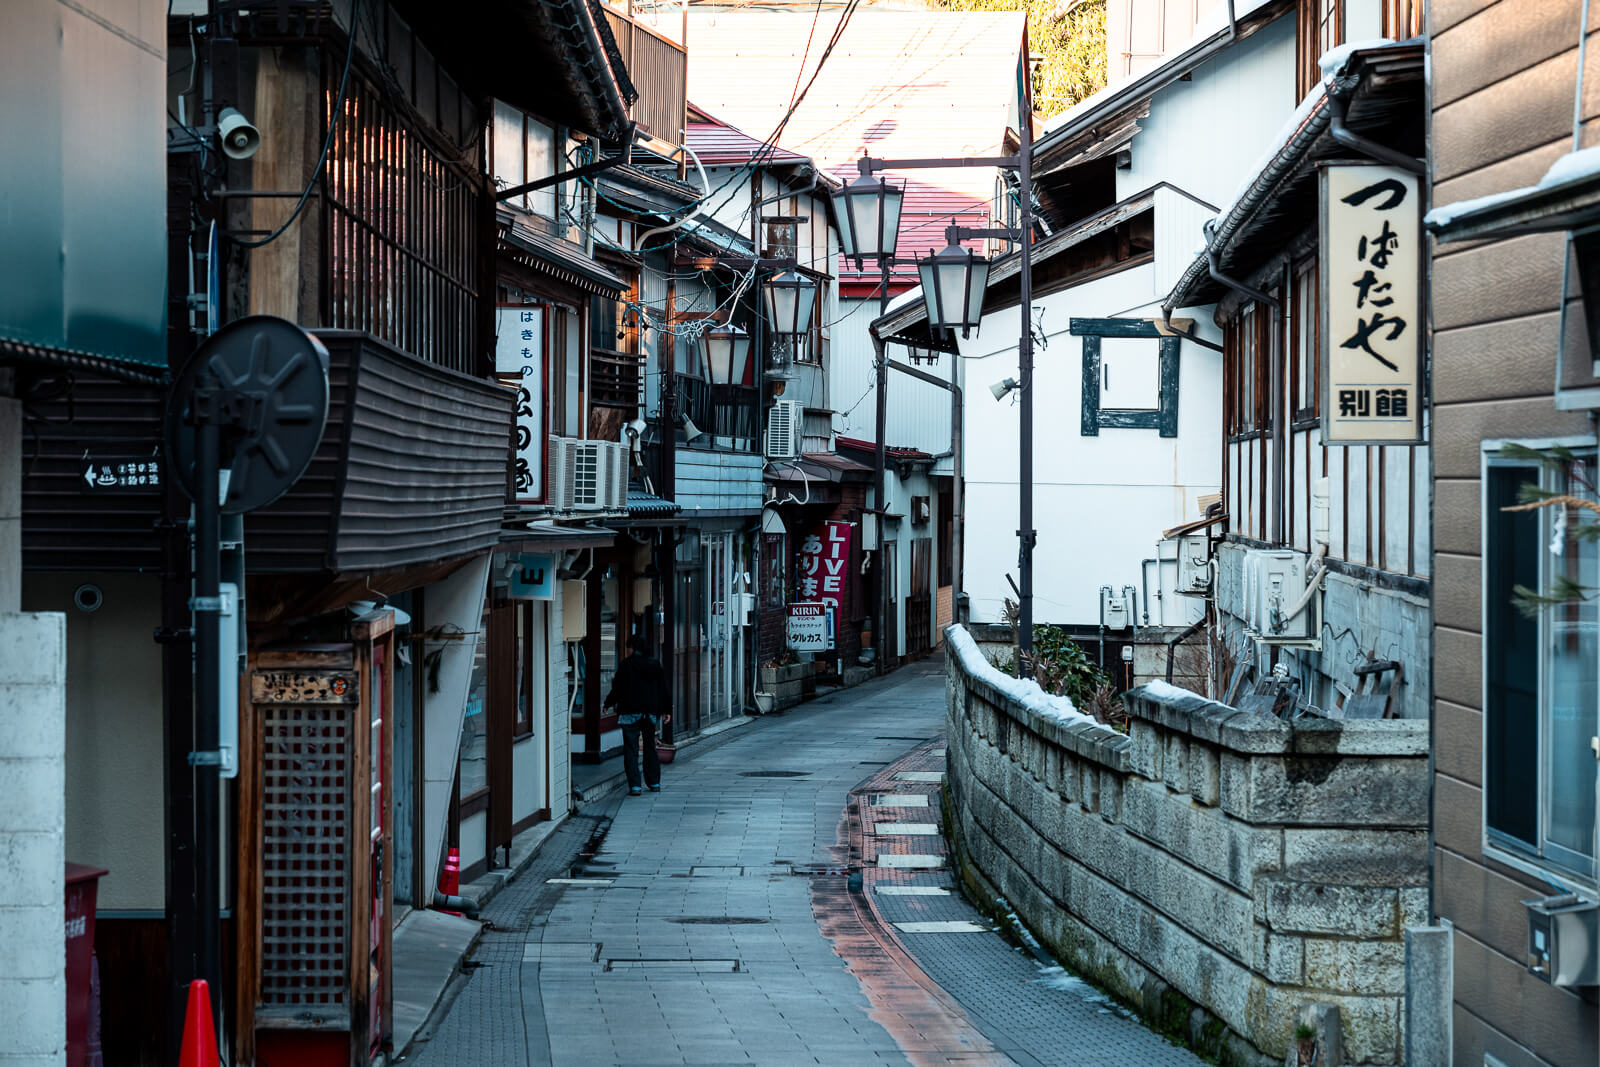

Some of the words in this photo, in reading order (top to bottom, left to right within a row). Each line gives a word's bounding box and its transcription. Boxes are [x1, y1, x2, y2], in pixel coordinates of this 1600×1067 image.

[1340, 178, 1408, 373] つばたや
[520, 311, 534, 377] はきもの
[1339, 388, 1408, 418] 別館
[801, 534, 823, 603] ありま
[792, 607, 820, 616] KIRIN
